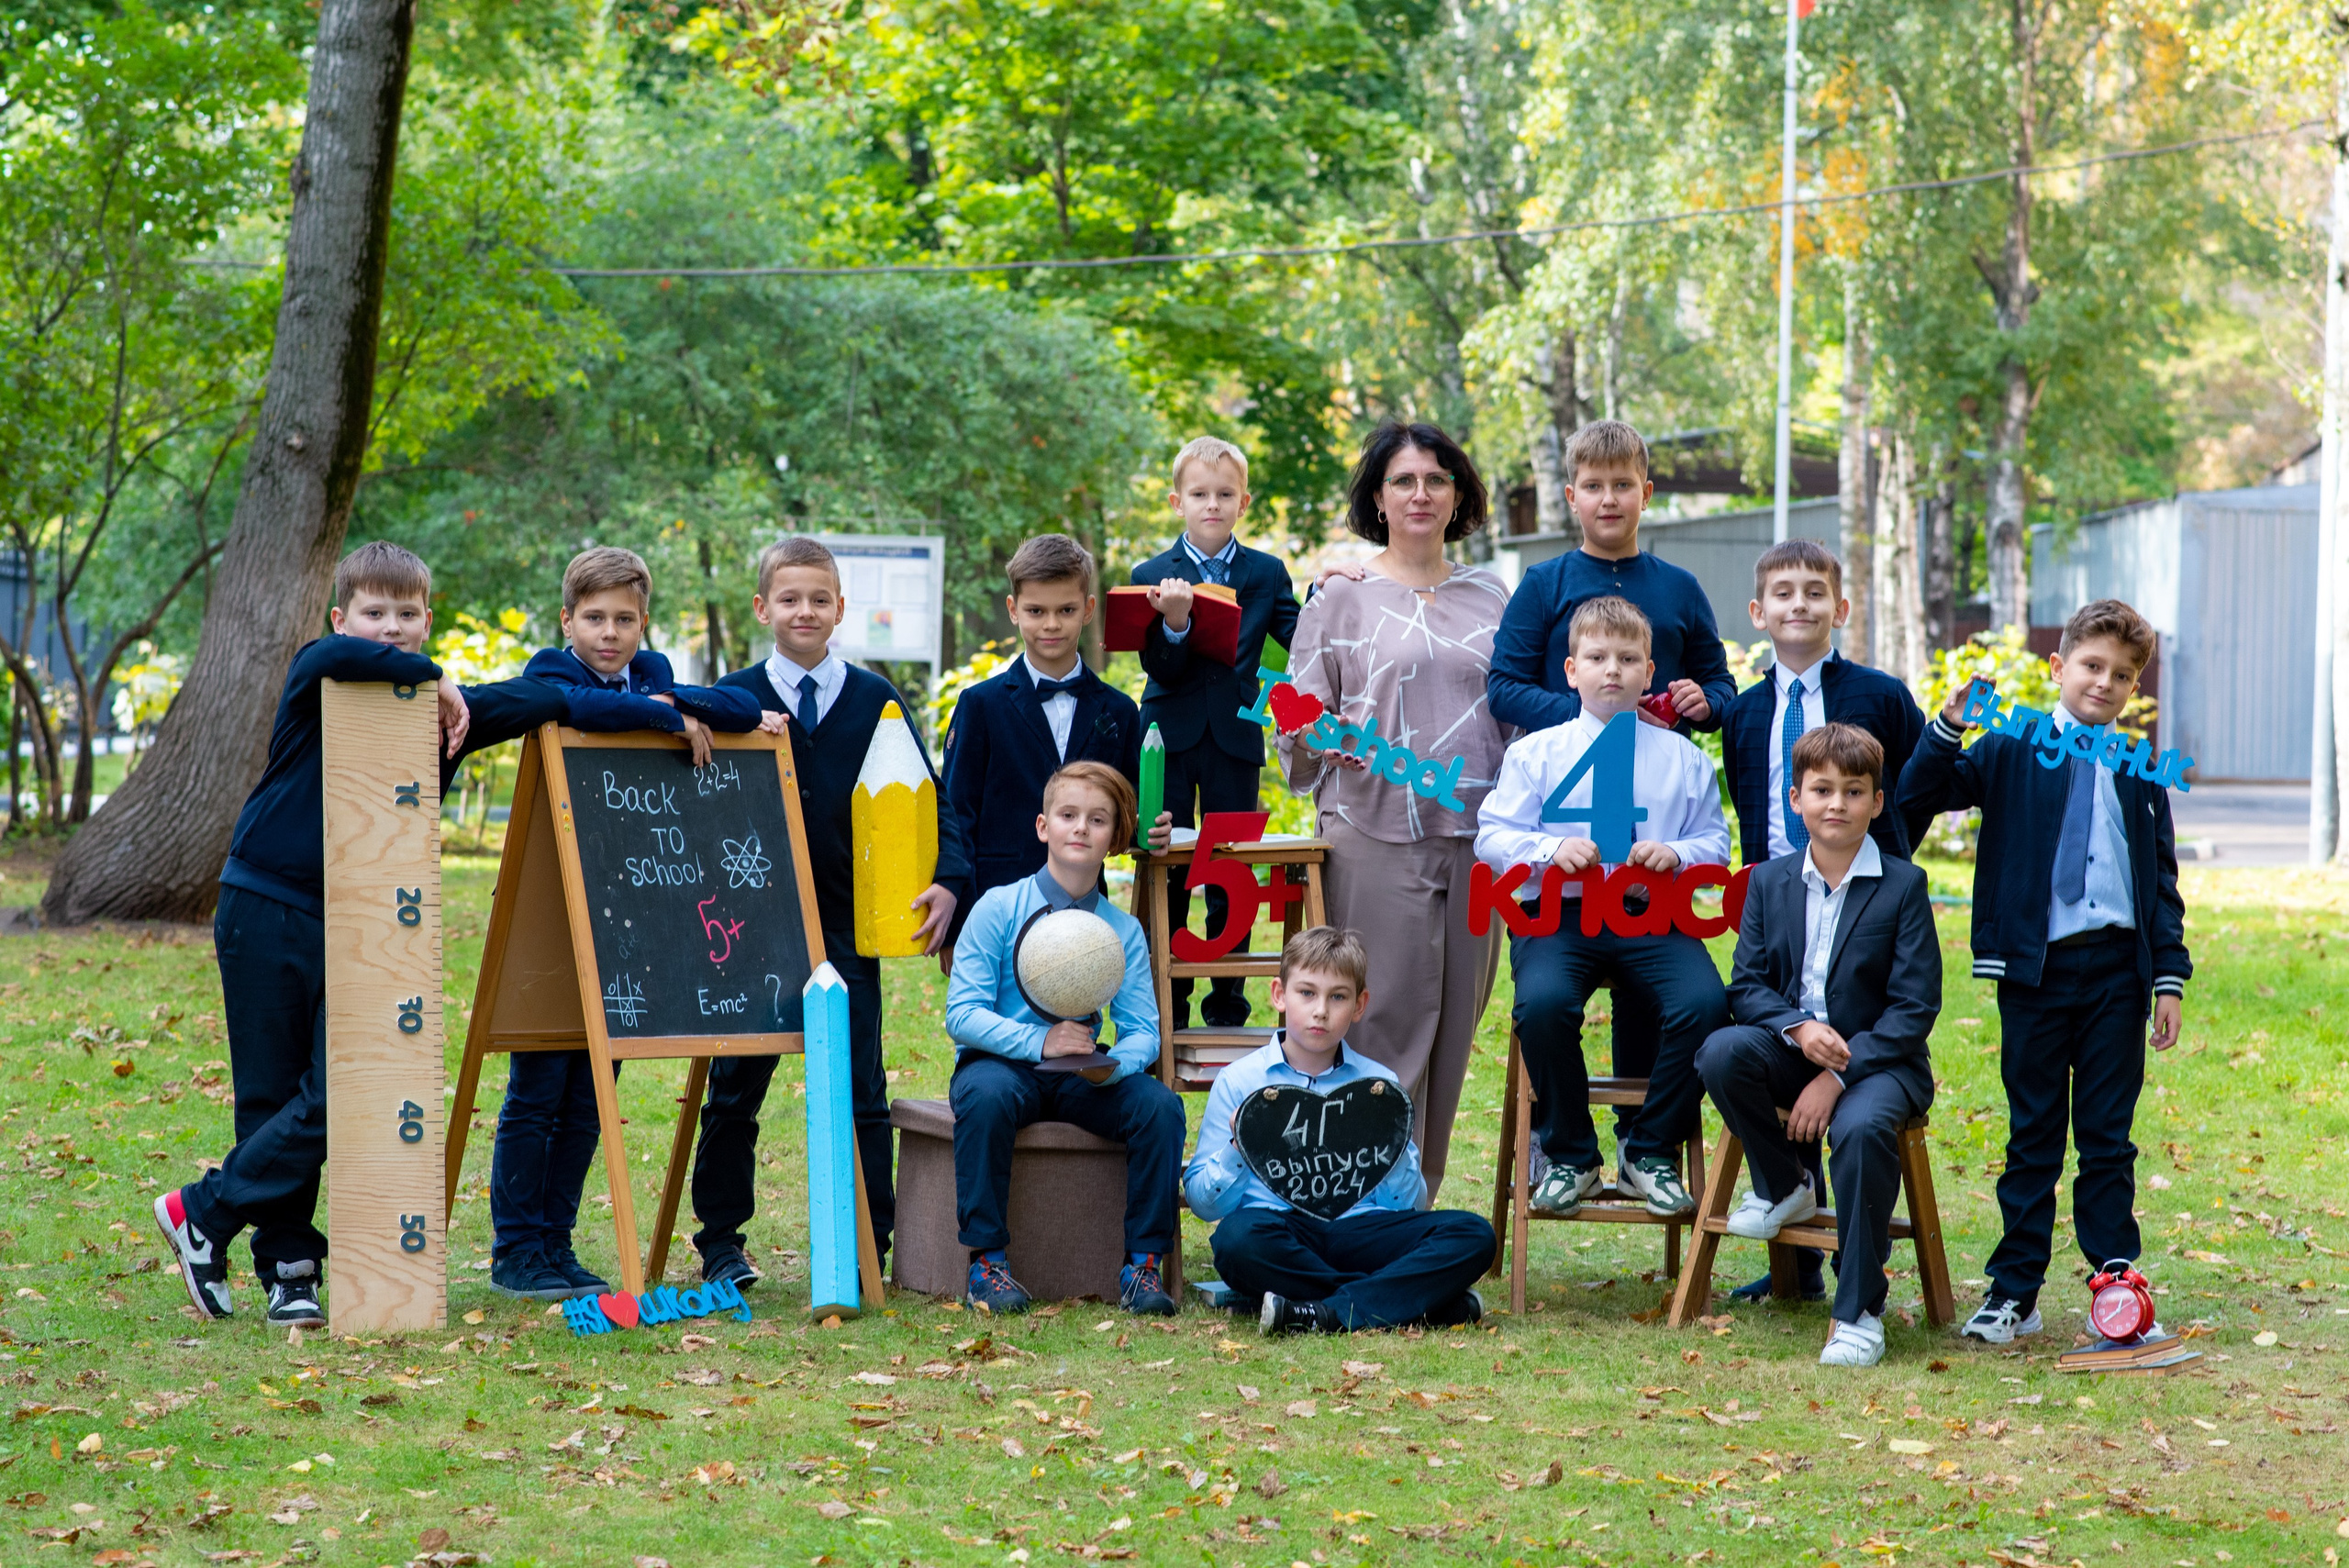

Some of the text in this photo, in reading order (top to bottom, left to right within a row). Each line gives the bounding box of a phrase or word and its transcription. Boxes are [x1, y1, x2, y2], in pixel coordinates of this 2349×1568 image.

[1237, 666, 1292, 727] I
[1962, 679, 2195, 793] Выпускник
[603, 770, 681, 815] Back
[1542, 711, 1648, 862] 4
[395, 887, 422, 928] 20
[1171, 811, 1303, 962] 5+
[698, 895, 744, 962] 5+
[396, 995, 423, 1034] 30
[765, 973, 783, 1024] ?
[397, 1099, 424, 1143] 40
[1287, 1169, 1365, 1201] 2024
[399, 1214, 426, 1253] 50
